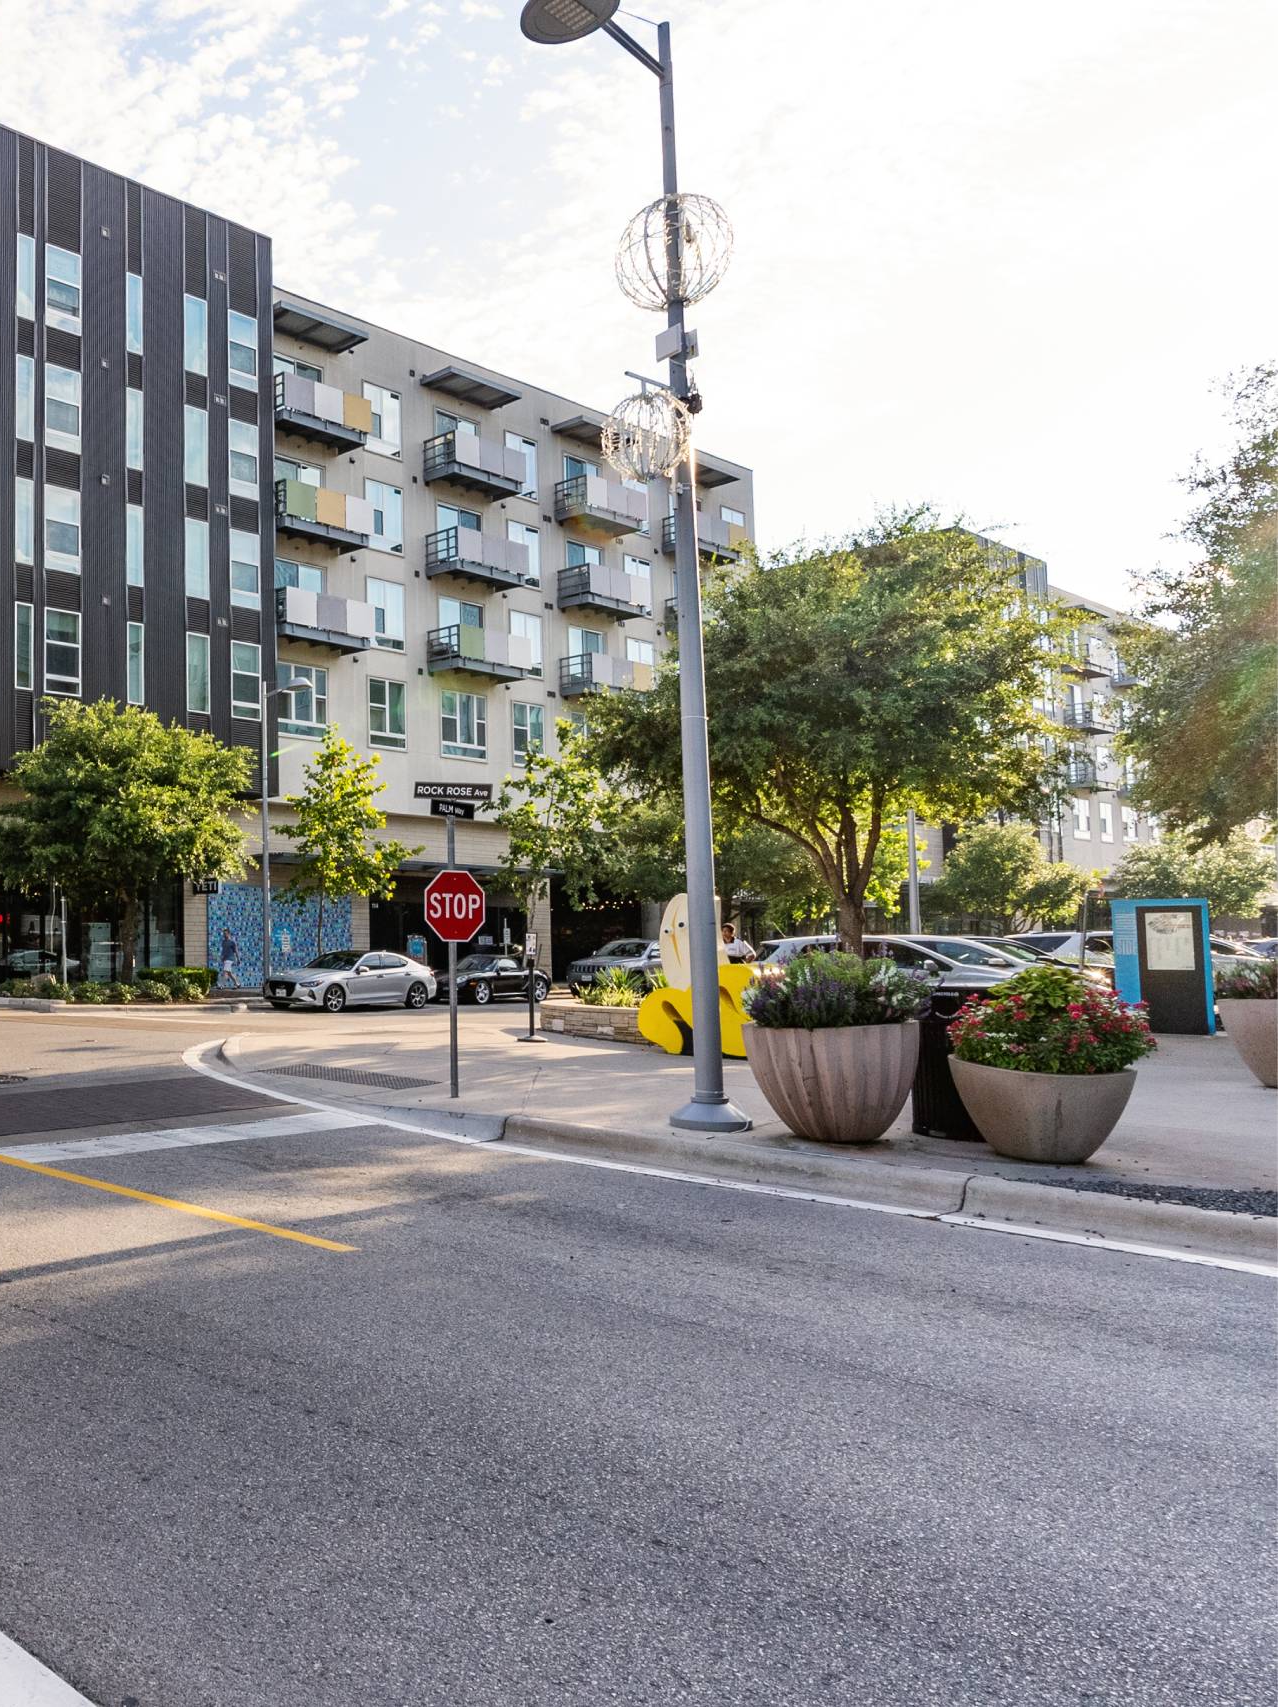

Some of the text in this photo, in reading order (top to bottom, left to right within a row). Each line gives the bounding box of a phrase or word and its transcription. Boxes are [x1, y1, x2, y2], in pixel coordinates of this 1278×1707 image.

[417, 785, 488, 797] ROCK ROSE Ave
[439, 803, 454, 814] PALM
[193, 880, 217, 892] YETI
[429, 892, 481, 920] STOP
